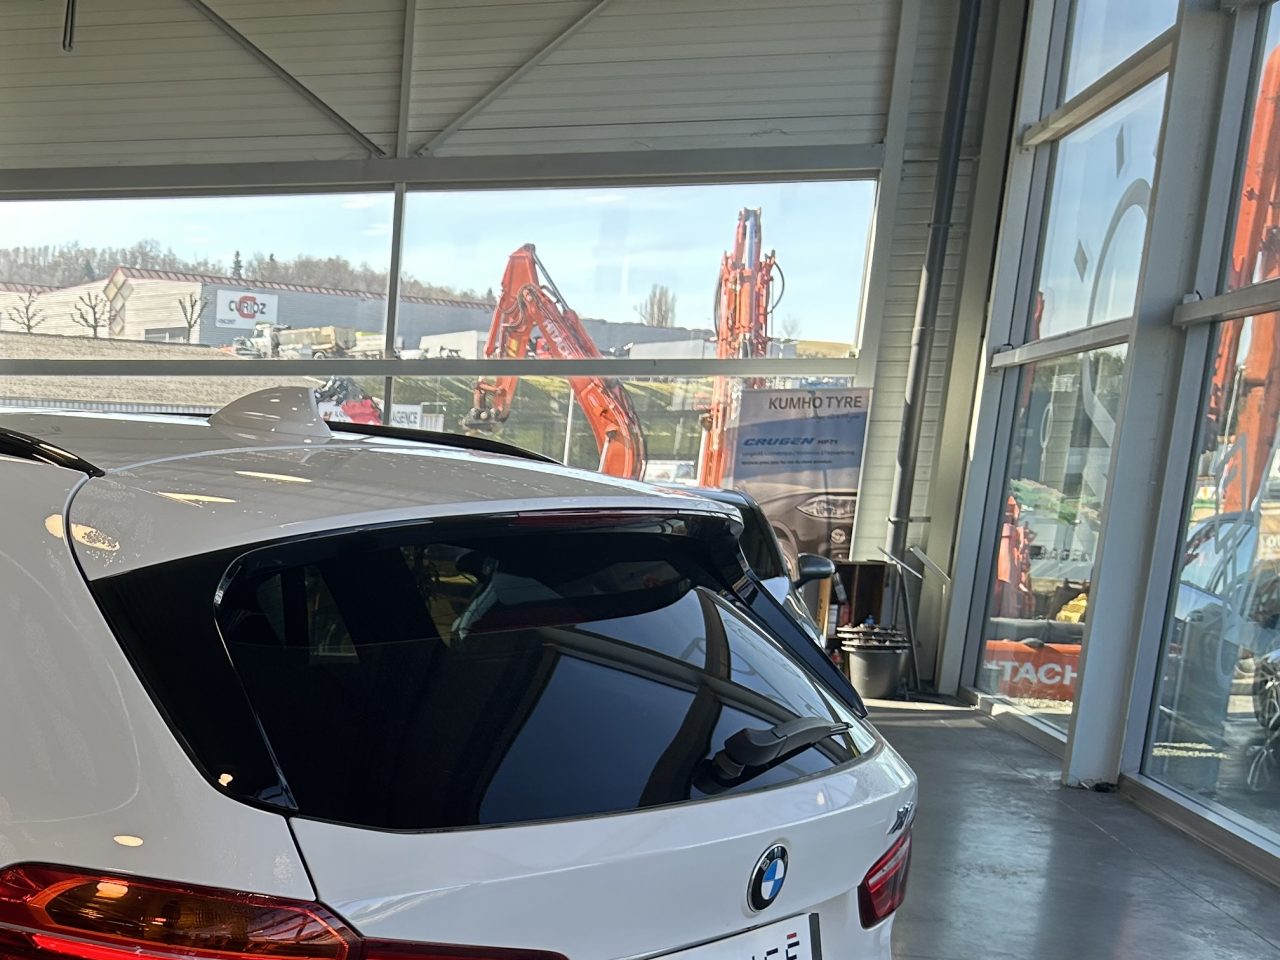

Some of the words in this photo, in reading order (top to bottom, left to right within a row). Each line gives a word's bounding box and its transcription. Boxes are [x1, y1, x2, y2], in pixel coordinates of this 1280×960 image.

[768, 395, 823, 410] KUMHO
[825, 395, 863, 409] TYRE
[743, 436, 814, 446] CRUGEN
